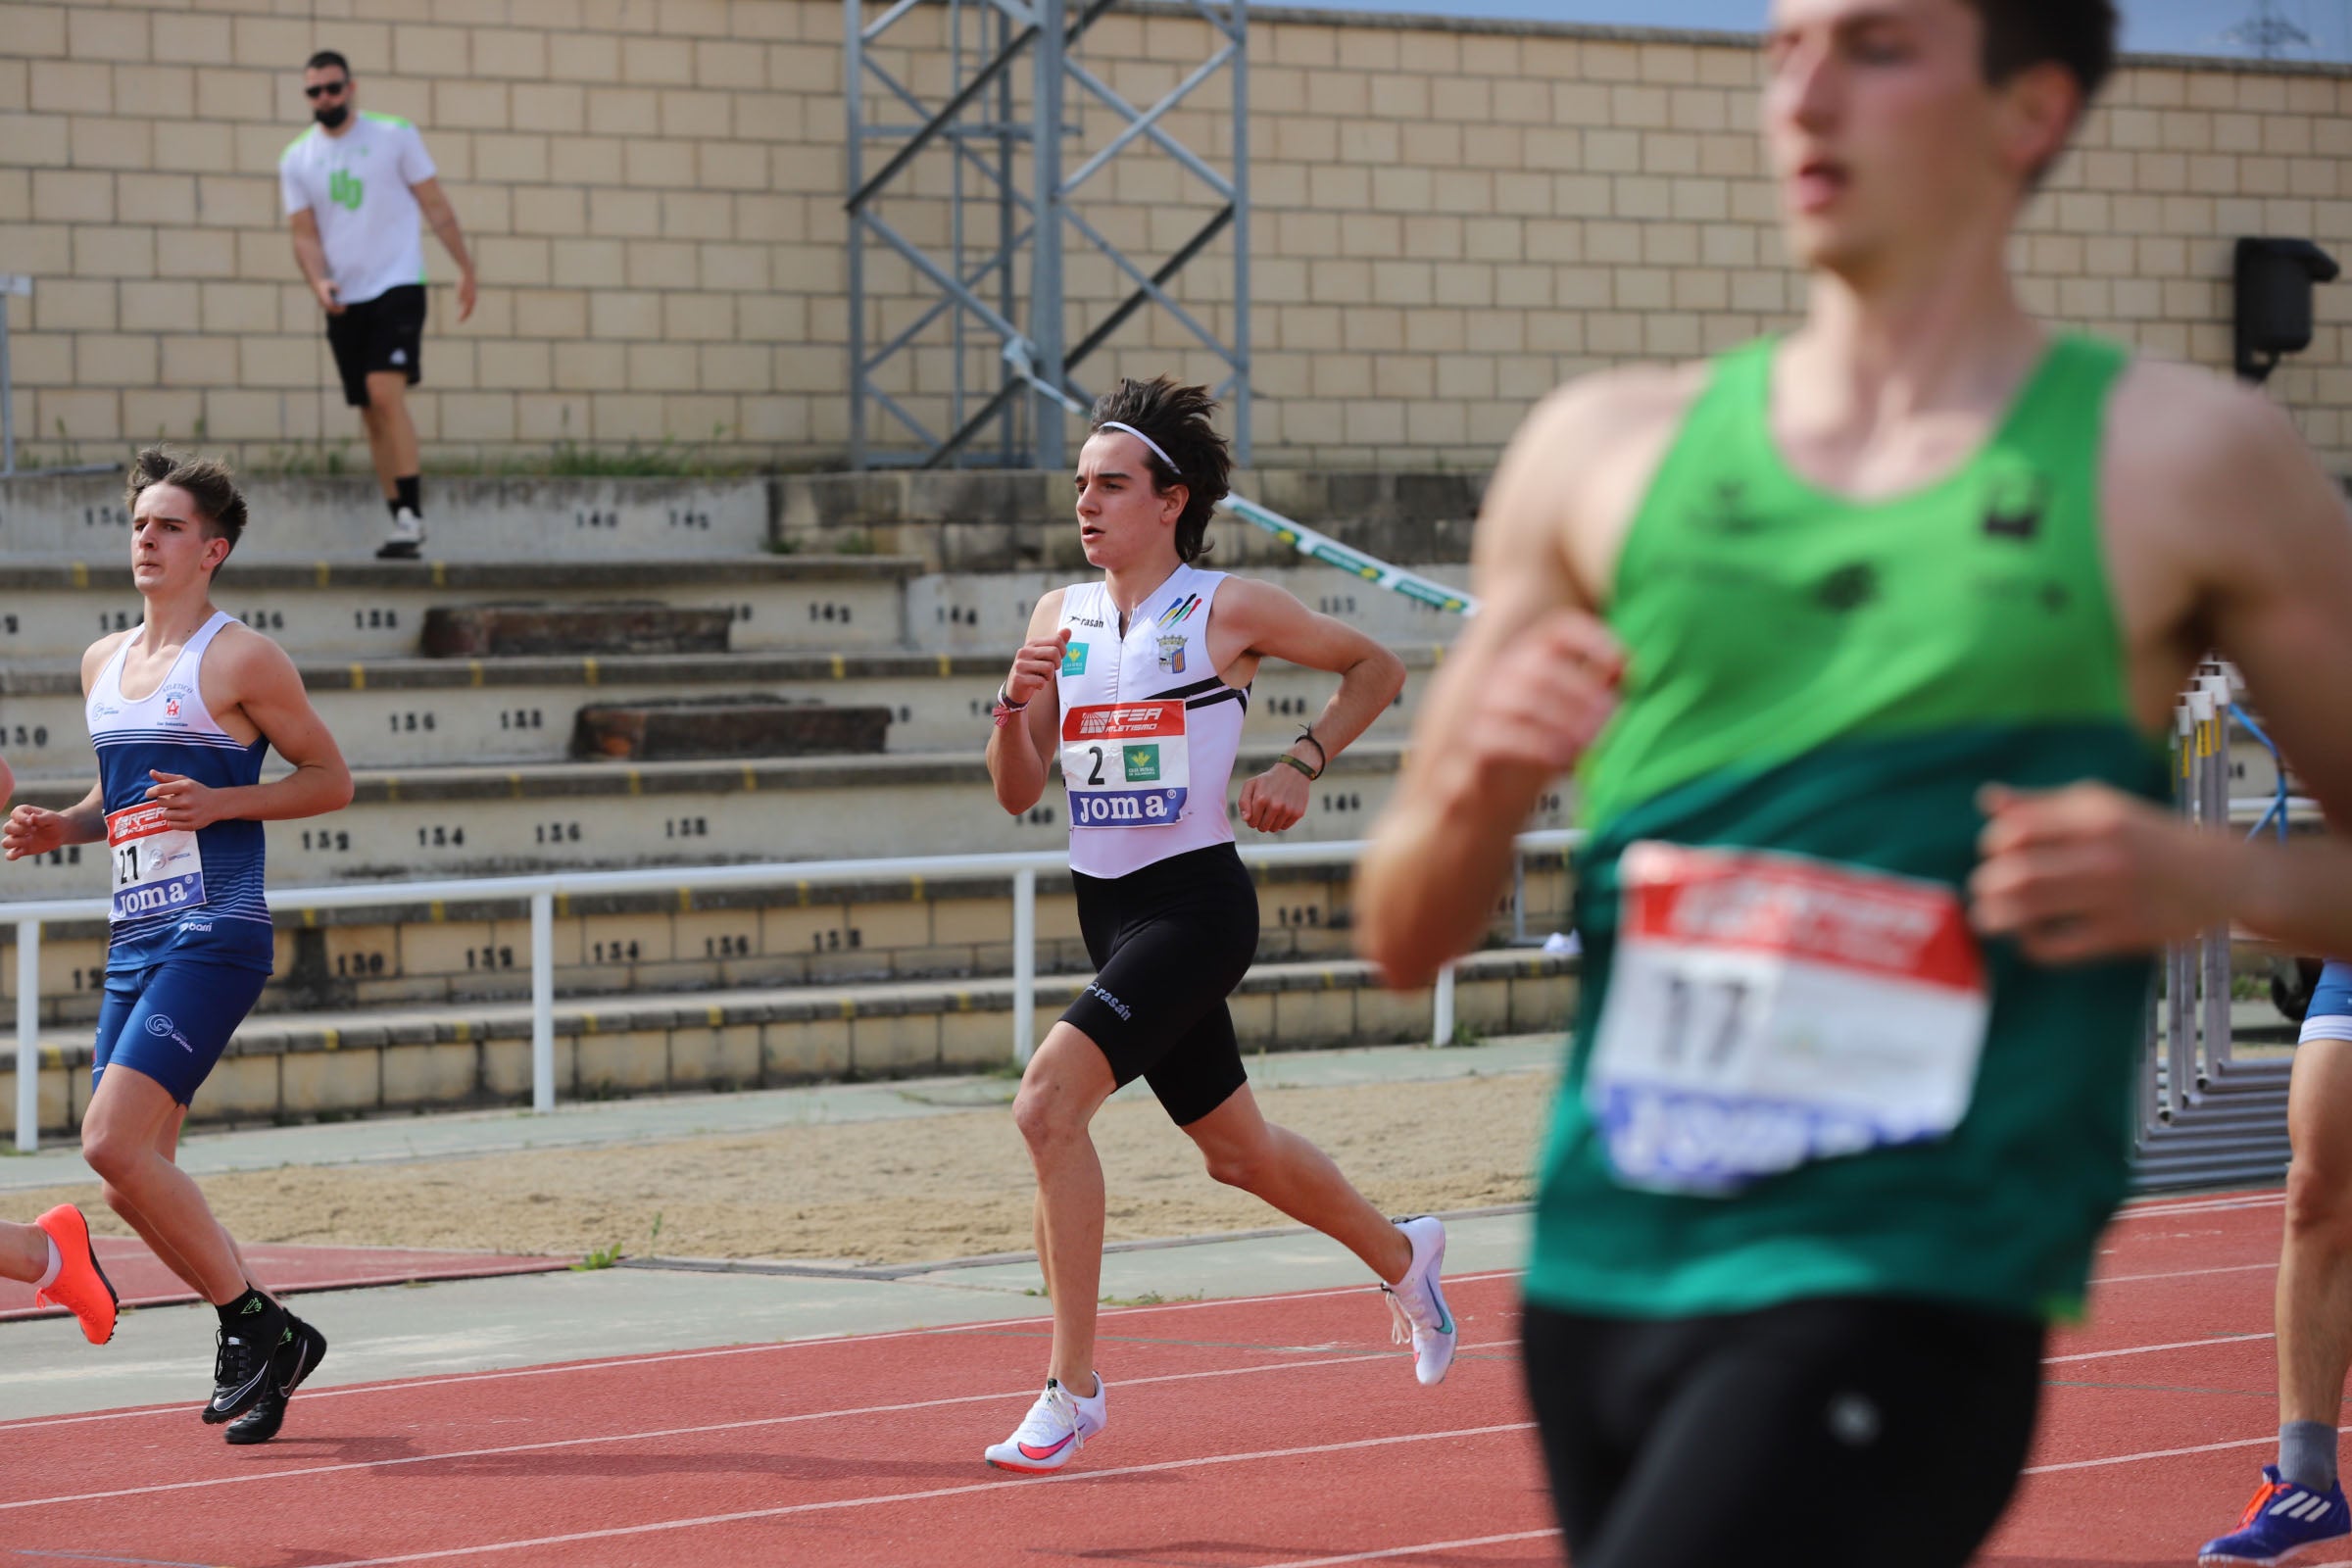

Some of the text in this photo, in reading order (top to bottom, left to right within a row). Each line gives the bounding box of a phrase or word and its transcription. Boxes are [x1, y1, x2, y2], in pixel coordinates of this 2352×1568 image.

[1080, 617, 1104, 628] rasan
[1108, 708, 1163, 725] RFEA
[1105, 723, 1157, 733] ATLETISMO
[1088, 746, 1105, 785] 2
[418, 825, 465, 848] 134
[120, 845, 139, 885] 21
[188, 922, 213, 933] barri
[1094, 988, 1132, 1021] rasan
